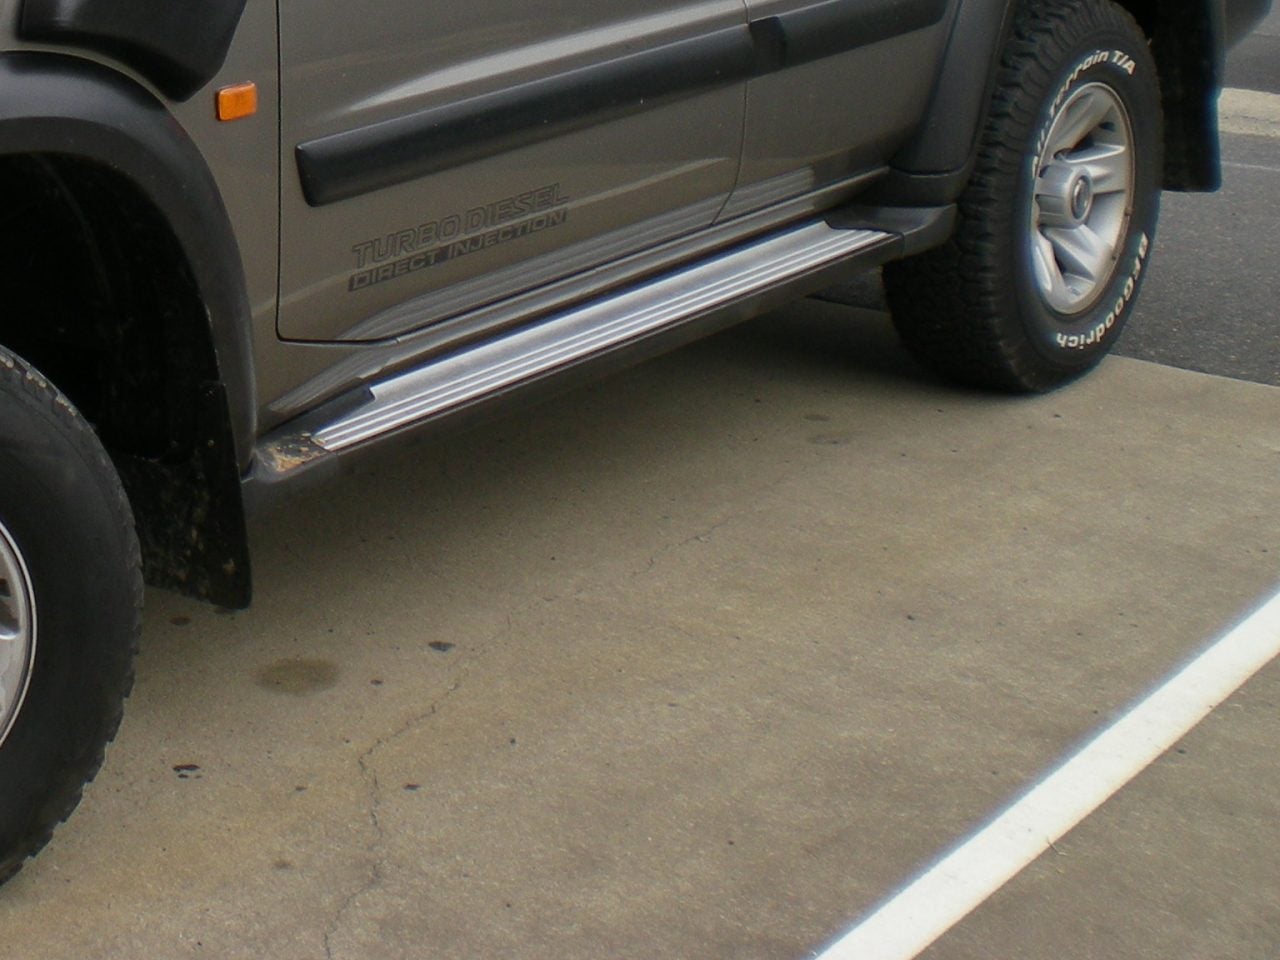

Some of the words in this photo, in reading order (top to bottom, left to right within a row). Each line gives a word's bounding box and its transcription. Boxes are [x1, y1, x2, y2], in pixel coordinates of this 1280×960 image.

[1112, 50, 1136, 75] T/A
[349, 251, 440, 291] DIRECT
[447, 207, 569, 260] INJECTION
[351, 215, 461, 269] TURBO
[467, 182, 570, 234] DIESEL
